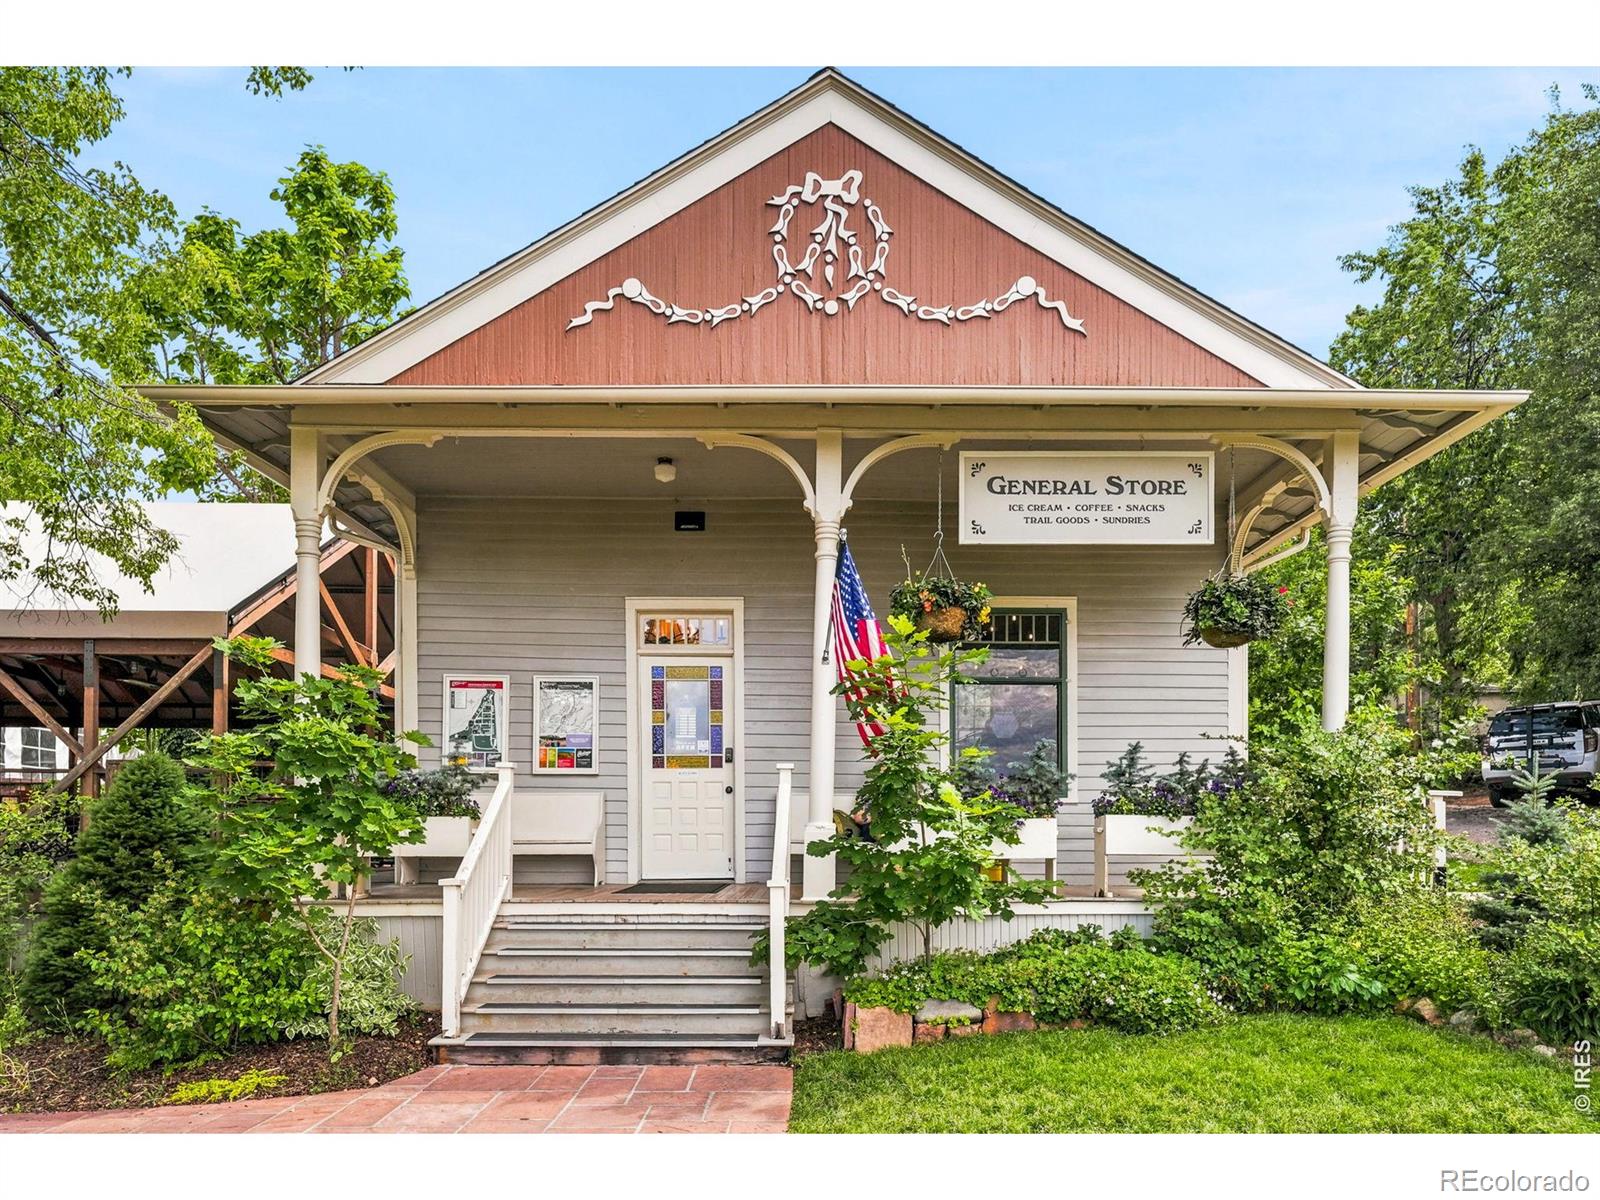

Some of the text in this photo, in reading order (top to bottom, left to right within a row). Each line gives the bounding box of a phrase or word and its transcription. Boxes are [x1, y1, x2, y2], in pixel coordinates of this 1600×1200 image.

[1008, 504, 1166, 512] ICE CREAM COFFEE SNACKS
[1024, 516, 1151, 525] TRAIL GOODS SUNDRIES
